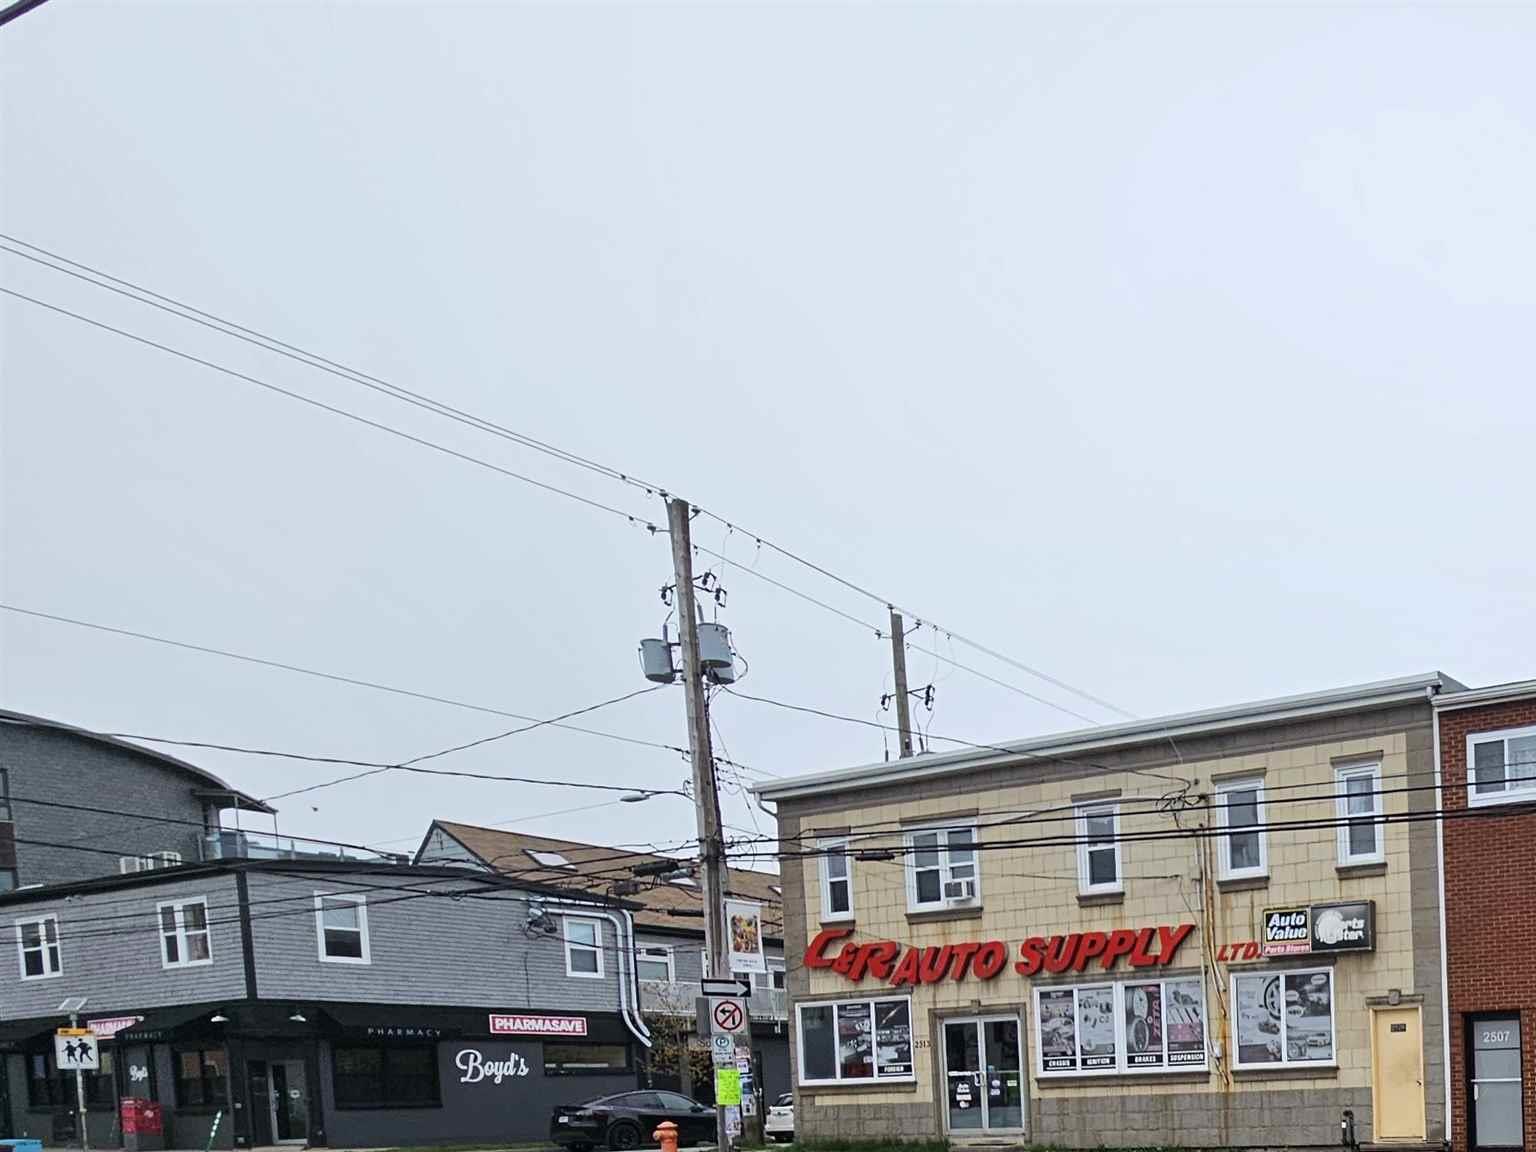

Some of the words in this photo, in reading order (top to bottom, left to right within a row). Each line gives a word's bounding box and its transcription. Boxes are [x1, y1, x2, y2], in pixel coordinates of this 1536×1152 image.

[1269, 912, 1306, 927] Auto
[1267, 926, 1307, 940] Value
[804, 929, 897, 981] C&R
[890, 941, 1008, 985] AUTO
[1015, 925, 1194, 976] SUPPLY
[495, 1018, 583, 1032] PHARMASAVE
[368, 1028, 441, 1037] PHARMACY
[1483, 1031, 1510, 1042] 2507
[455, 1049, 529, 1084] Boyd's
